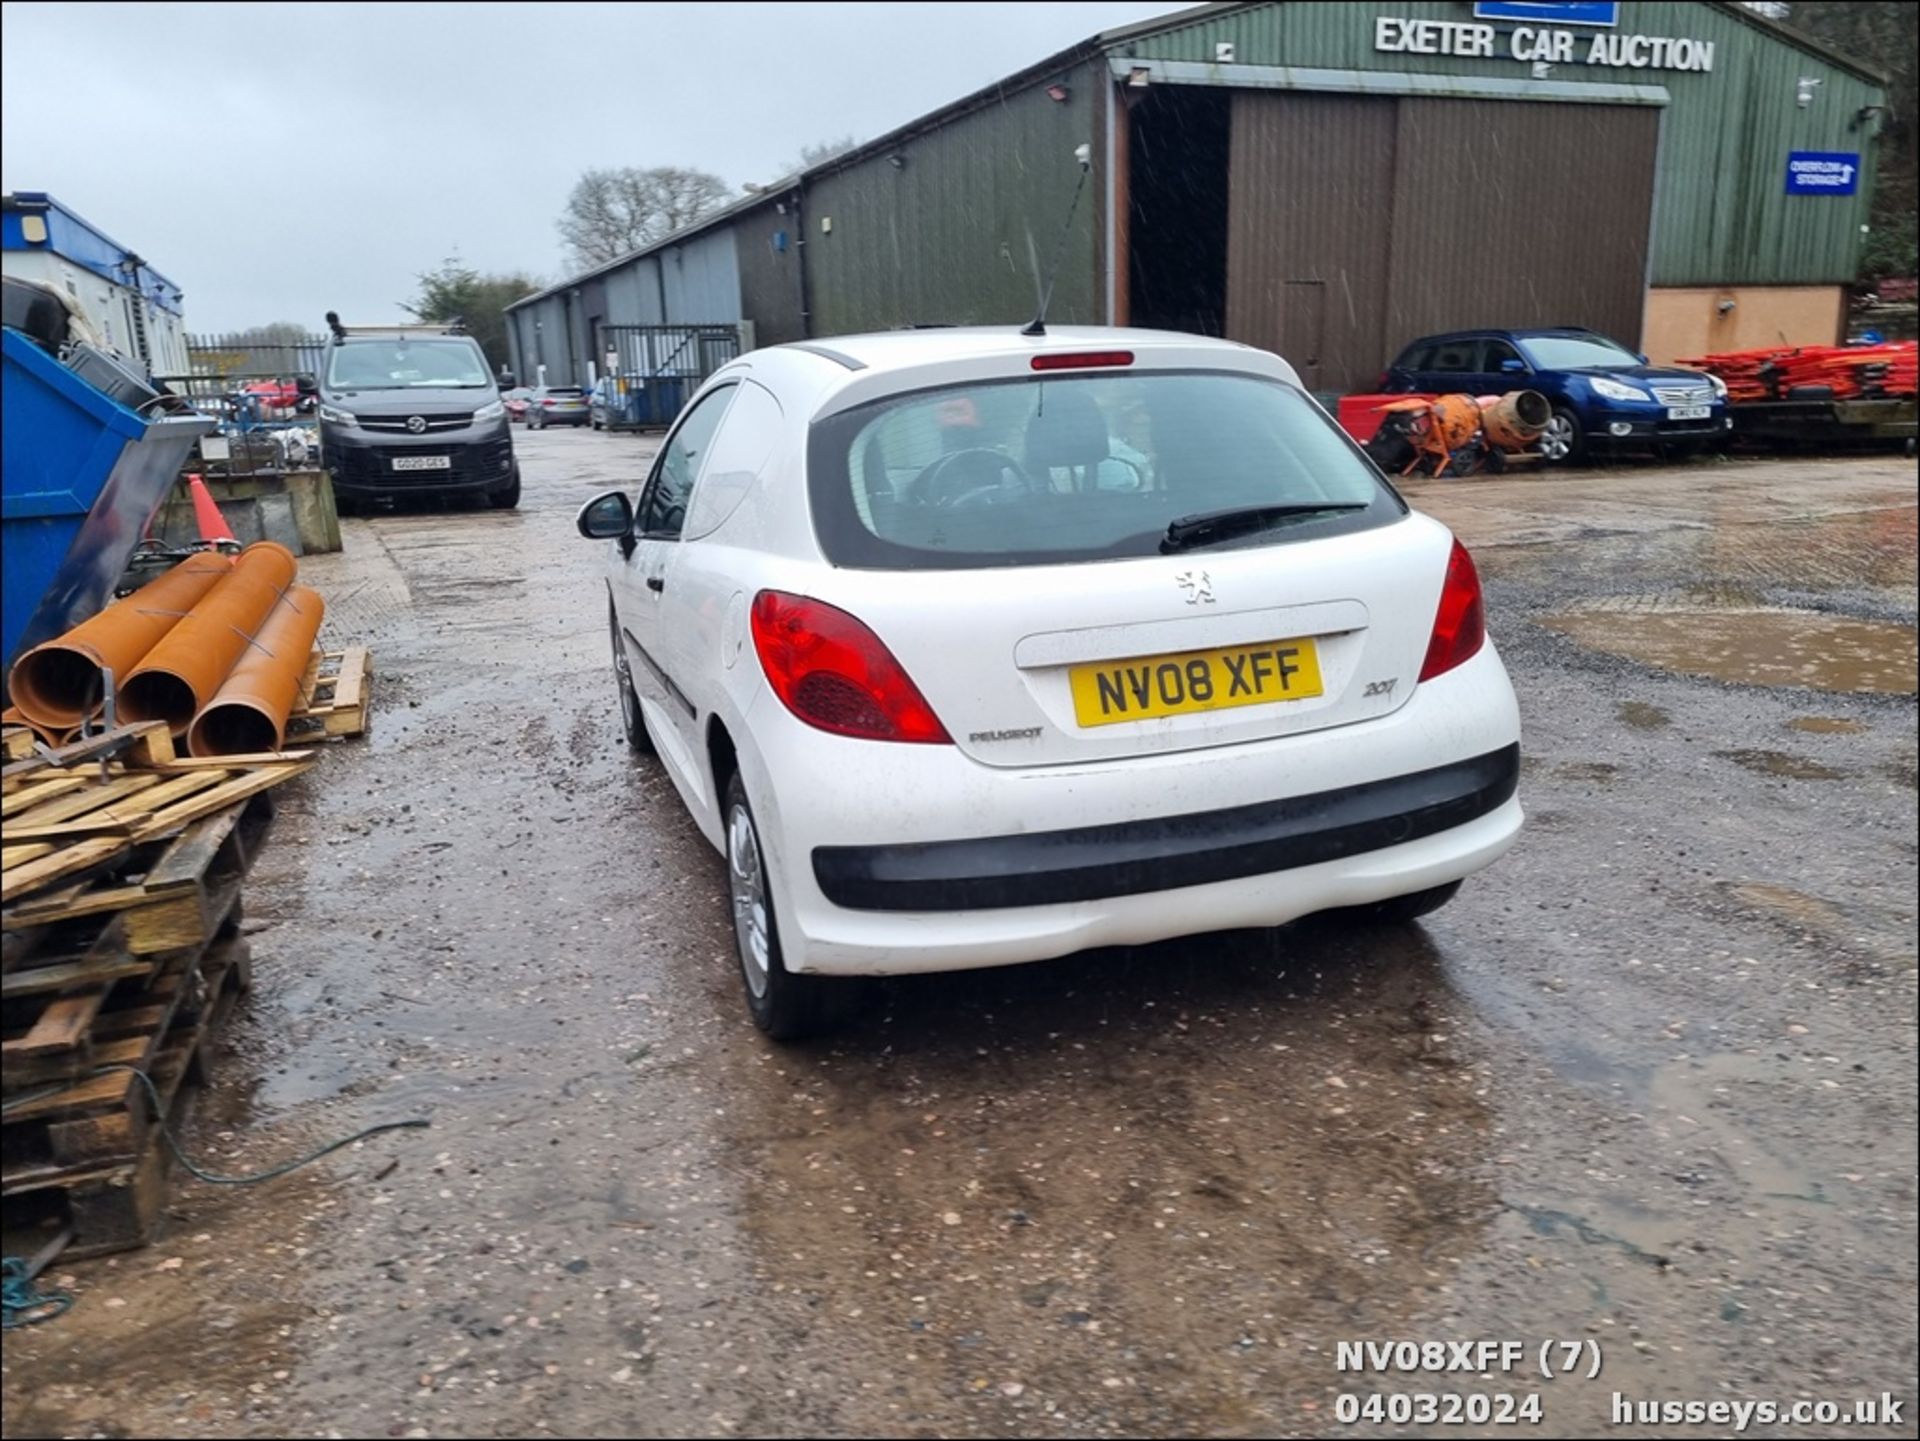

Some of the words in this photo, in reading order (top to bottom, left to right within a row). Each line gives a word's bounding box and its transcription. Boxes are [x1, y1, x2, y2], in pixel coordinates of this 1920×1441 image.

[1375, 17, 1495, 57] EXETER
[1511, 27, 1575, 62] CAR
[1587, 34, 1714, 72] AUCTION
[1096, 660, 1214, 715] NV08
[1223, 648, 1300, 697] XFF
[1362, 677, 1399, 698] 207
[969, 726, 1044, 742] PEUGEOT
